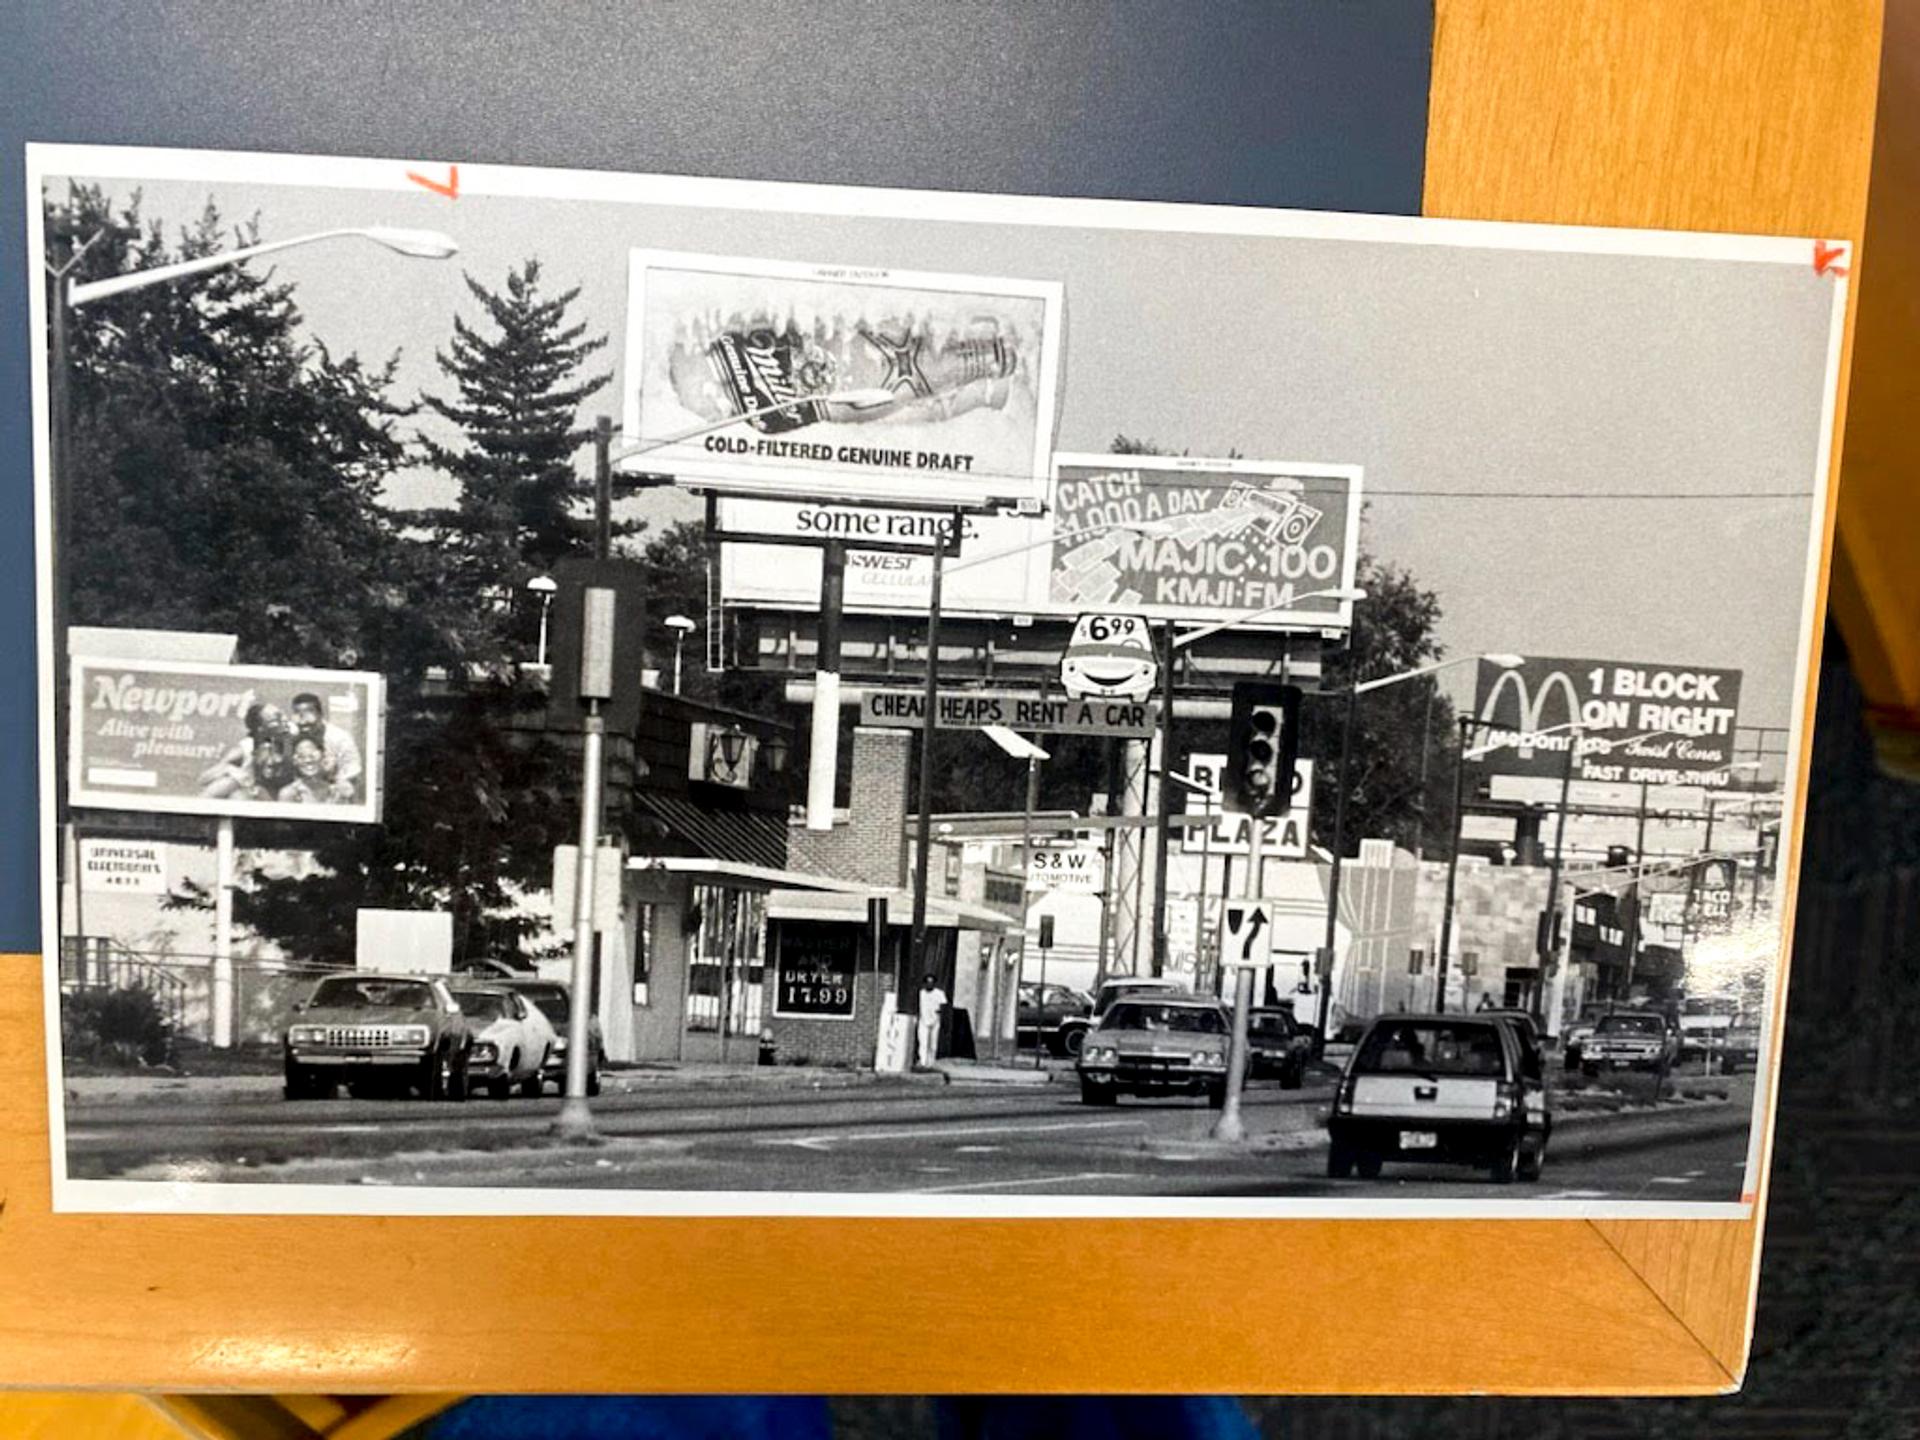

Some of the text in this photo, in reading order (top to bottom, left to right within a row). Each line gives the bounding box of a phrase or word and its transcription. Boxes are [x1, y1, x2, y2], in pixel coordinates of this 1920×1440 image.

[721, 335, 752, 394] Genuine
[746, 331, 804, 424] Miller
[704, 435, 974, 471] COLD-FILTERED GENUINE DRAFT
[1058, 470, 1142, 511] CATCH
[1147, 492, 1163, 518] A
[1167, 488, 1212, 515] DAY
[797, 509, 881, 534] some
[1118, 540, 1337, 580] MAJIC 100
[91, 674, 256, 721] Newport
[1588, 669, 1721, 700] 1 BLOCK
[941, 697, 1002, 720] HEAPS
[1016, 702, 1068, 723] RENT
[1078, 703, 1093, 724] A
[1105, 705, 1145, 727] CAR
[1582, 701, 1734, 734] ON RIGHT
[97, 718, 194, 741] Alive with
[1583, 765, 1622, 780] FAST
[1033, 851, 1086, 869] S & W
